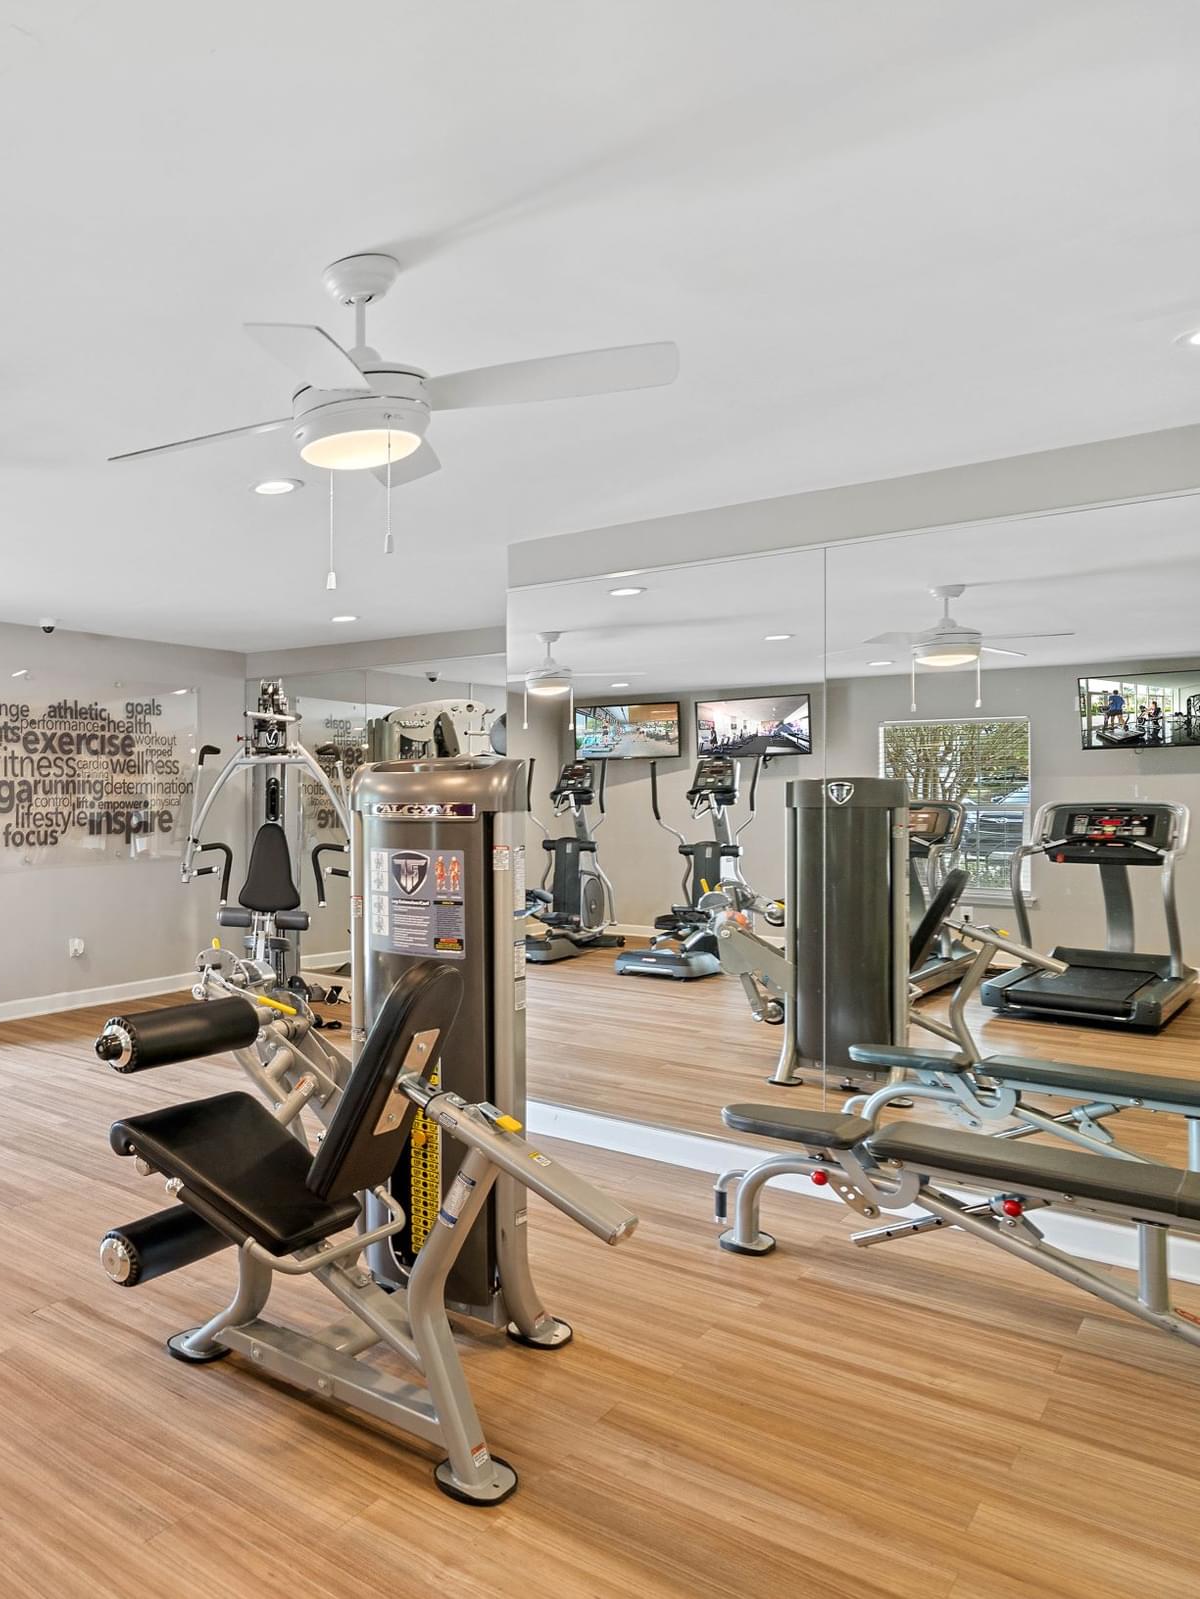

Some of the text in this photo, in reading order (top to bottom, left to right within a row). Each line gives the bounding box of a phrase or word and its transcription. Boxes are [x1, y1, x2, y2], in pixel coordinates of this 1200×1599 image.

[47, 699, 108, 722] athletic
[125, 698, 162, 719] goals
[21, 713, 100, 733] performance
[107, 713, 152, 735] health
[22, 724, 177, 757] exercise workout
[145, 746, 173, 759] ripped
[77, 755, 109, 770] cardio
[109, 751, 180, 775] wellness
[33, 773, 104, 801] running
[104, 777, 194, 796] determination
[34, 793, 182, 812] control lift empower physical
[15, 800, 173, 844] lifestyle inspire
[3, 823, 59, 847] focus
